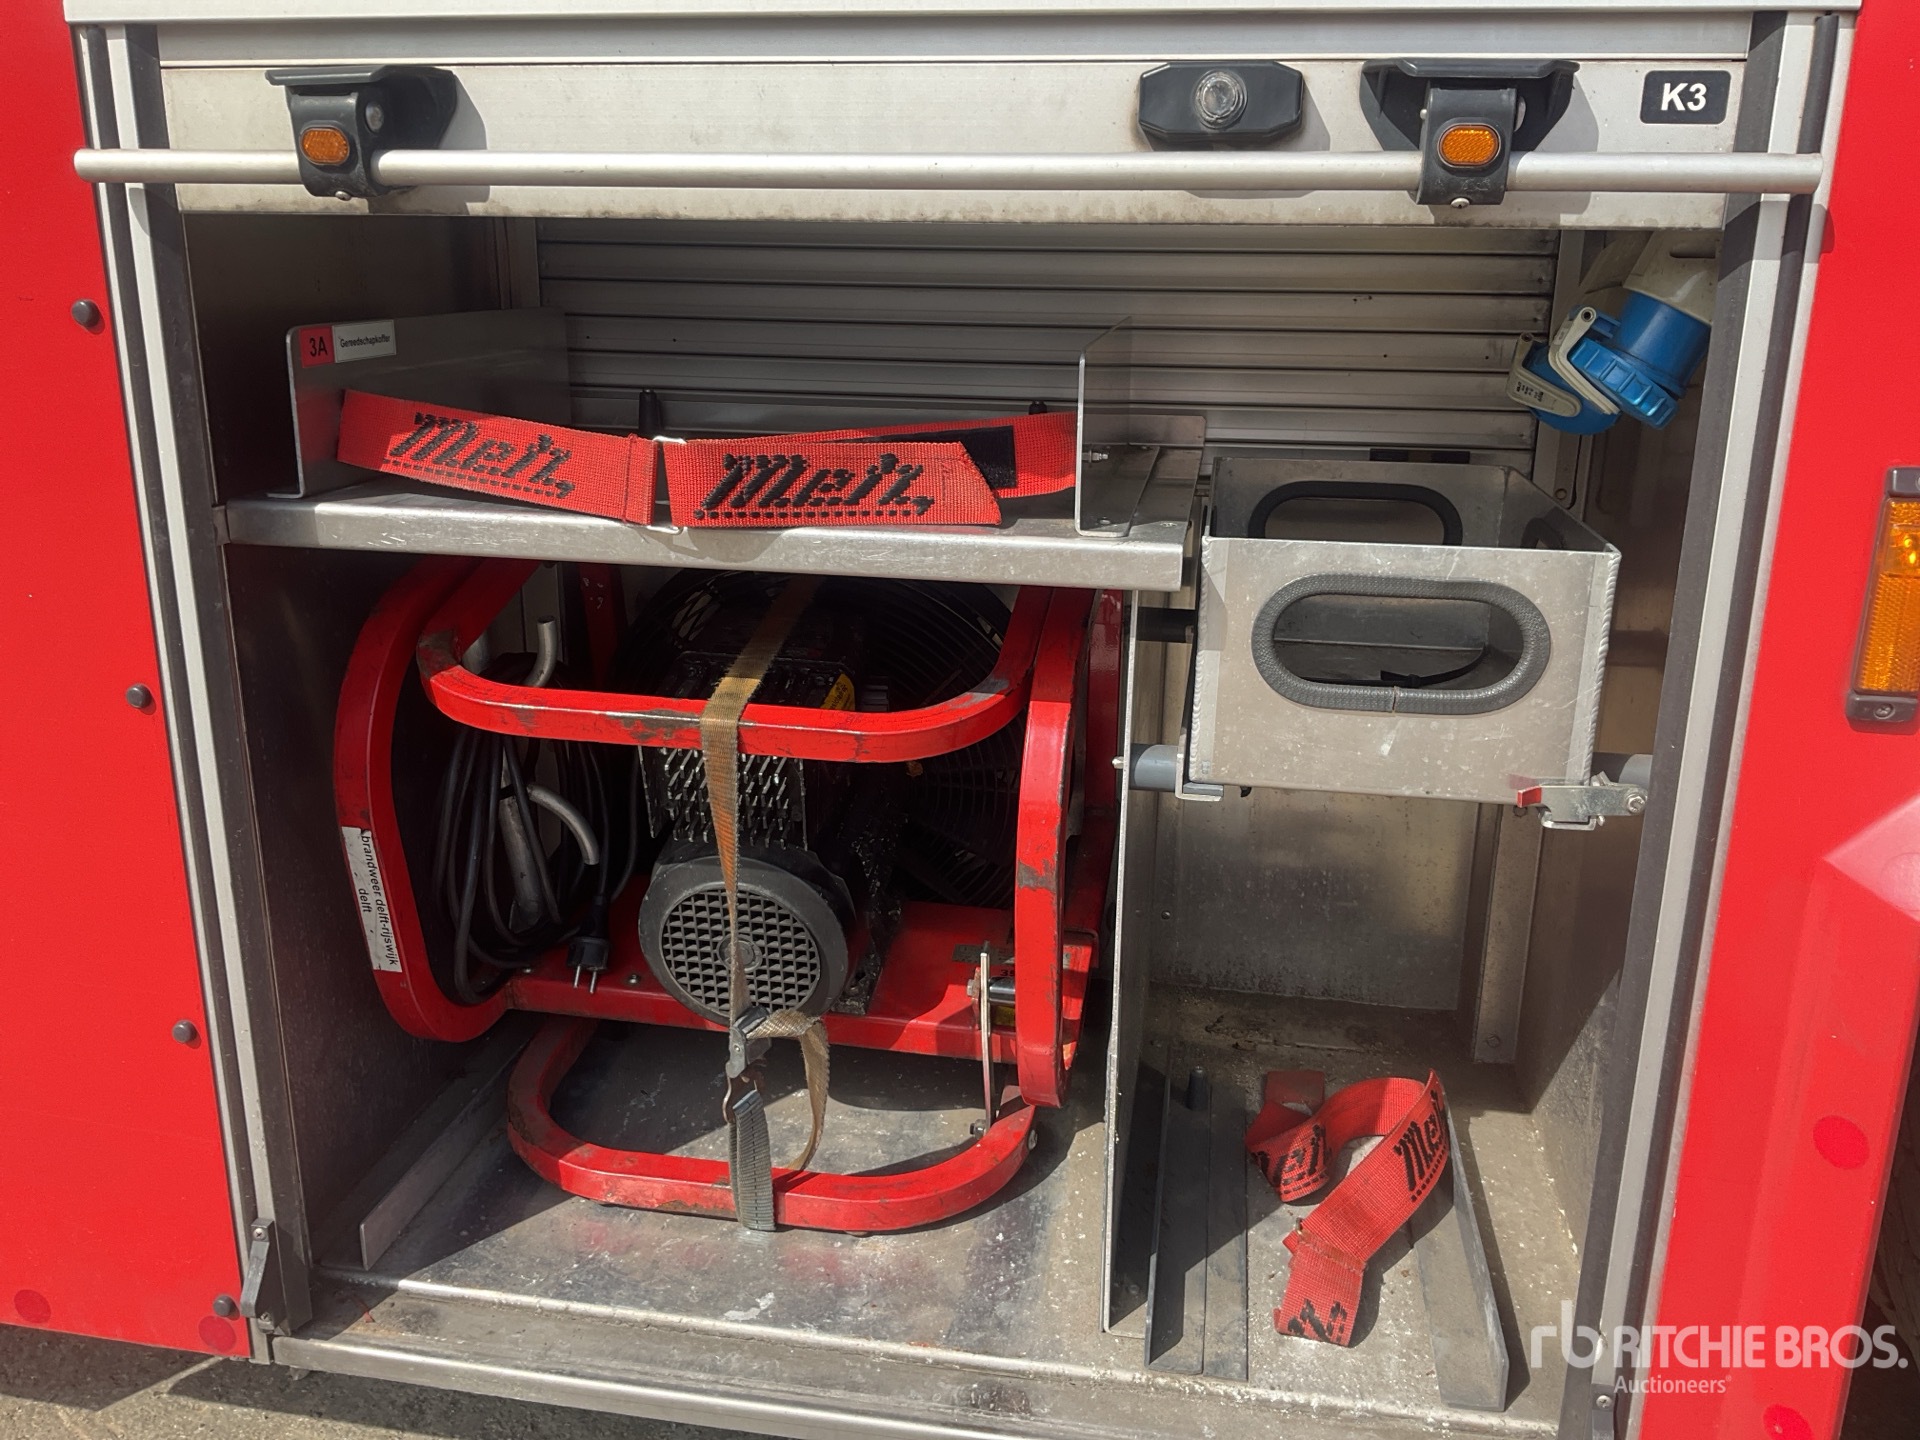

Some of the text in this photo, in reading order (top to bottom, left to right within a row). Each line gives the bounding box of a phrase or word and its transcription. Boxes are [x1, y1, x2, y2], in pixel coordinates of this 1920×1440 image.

[1660, 82, 1707, 111] K3
[309, 336, 328, 357] 3A
[358, 888, 372, 913] delft
[360, 835, 399, 966] brandweer delft-rijswijk
